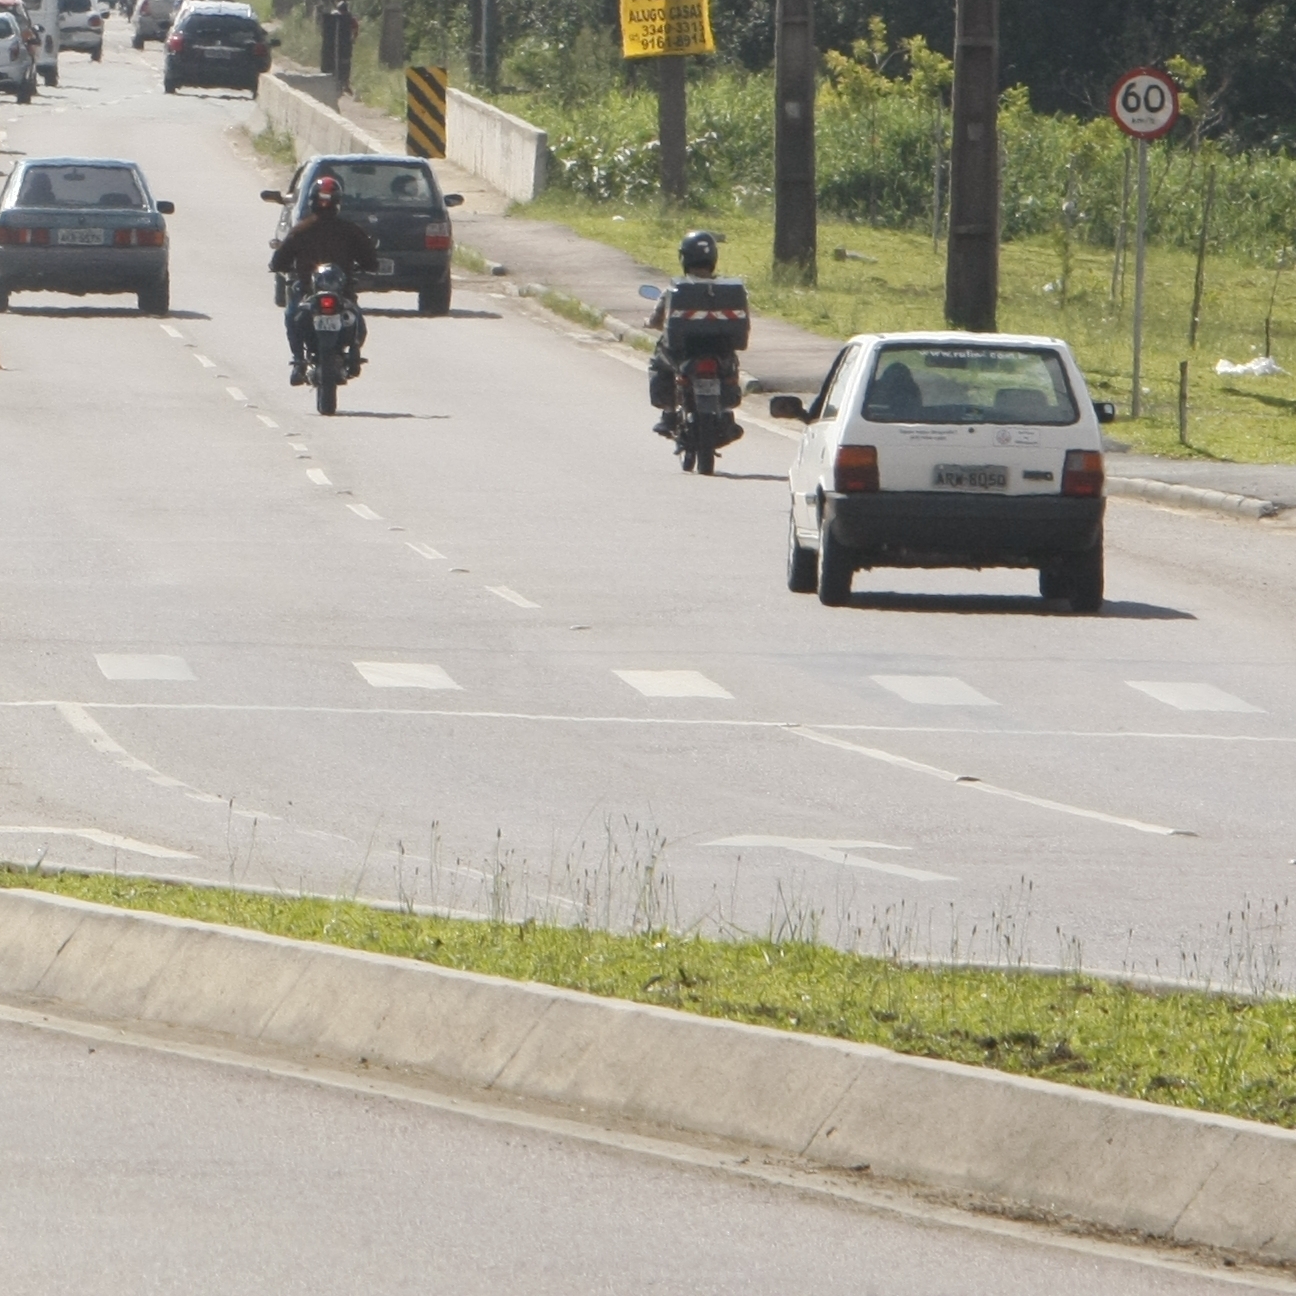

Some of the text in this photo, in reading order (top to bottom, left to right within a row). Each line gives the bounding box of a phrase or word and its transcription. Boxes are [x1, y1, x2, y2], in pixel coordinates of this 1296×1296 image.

[629, 4, 703, 24] ALUGO CASAS
[1122, 82, 1165, 113] 60
